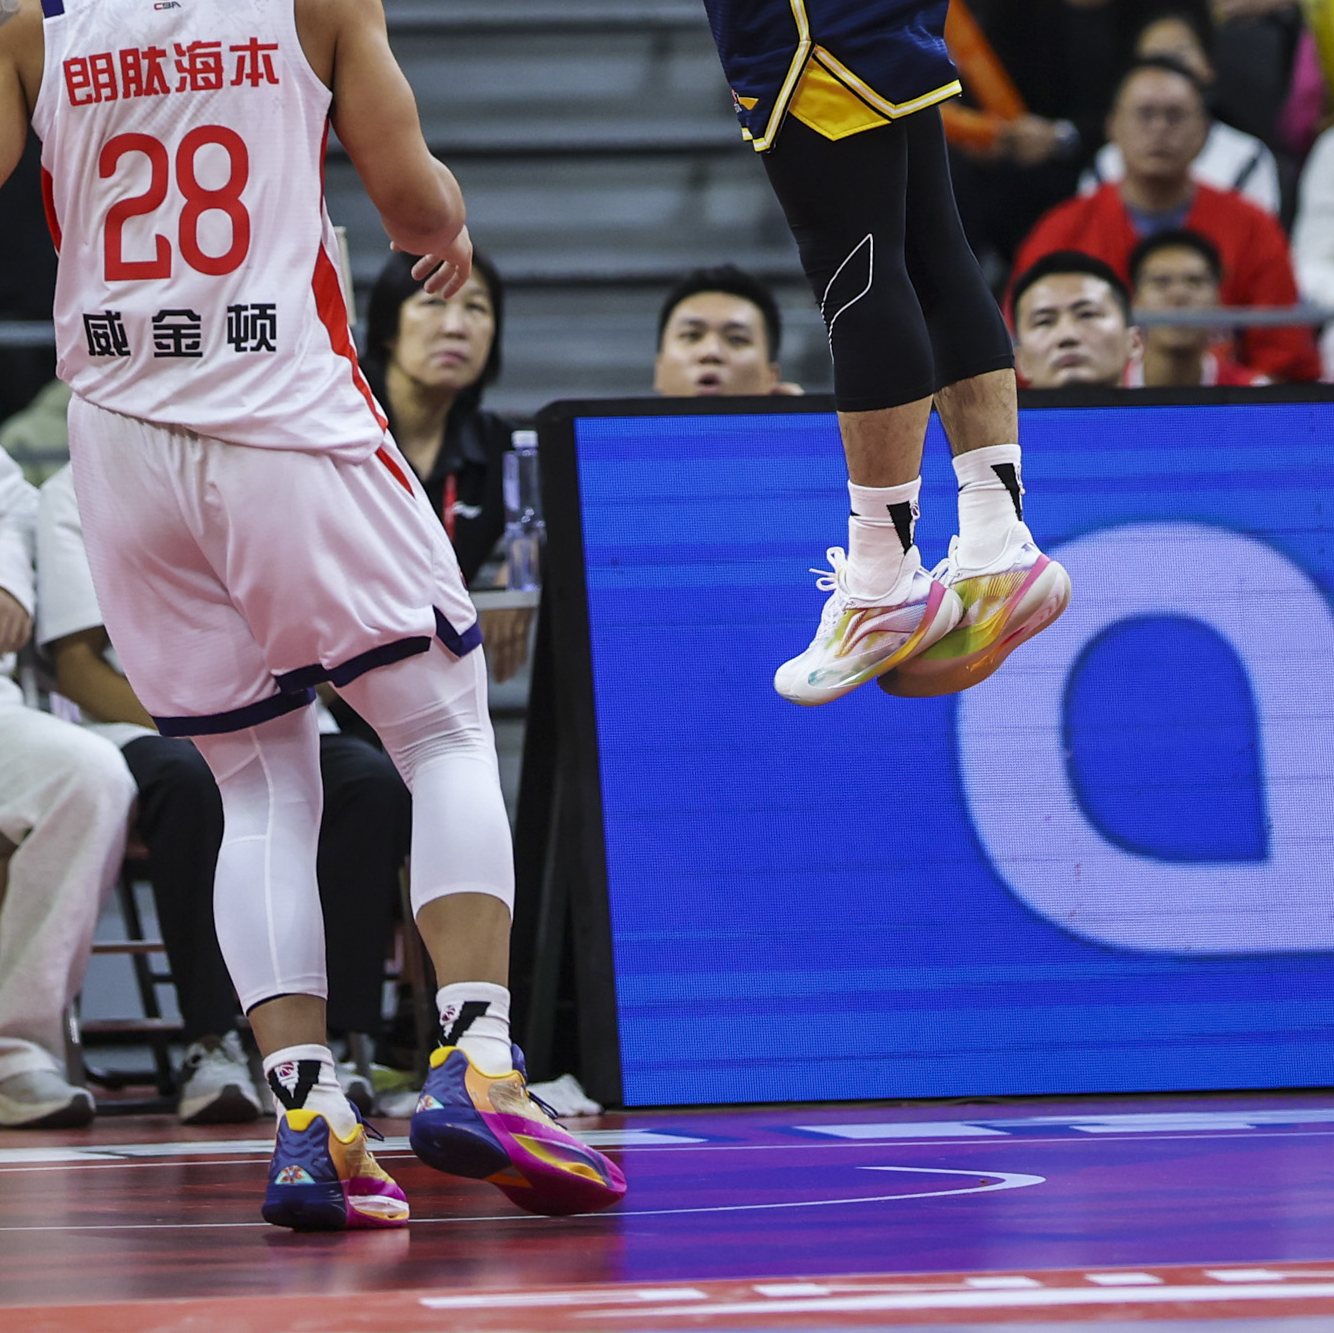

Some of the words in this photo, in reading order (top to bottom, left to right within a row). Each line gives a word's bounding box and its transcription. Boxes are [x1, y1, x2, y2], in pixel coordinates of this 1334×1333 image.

[62, 37, 280, 107] 朗肽海本
[98, 124, 250, 282] 28
[82, 303, 277, 359] 威金顿
